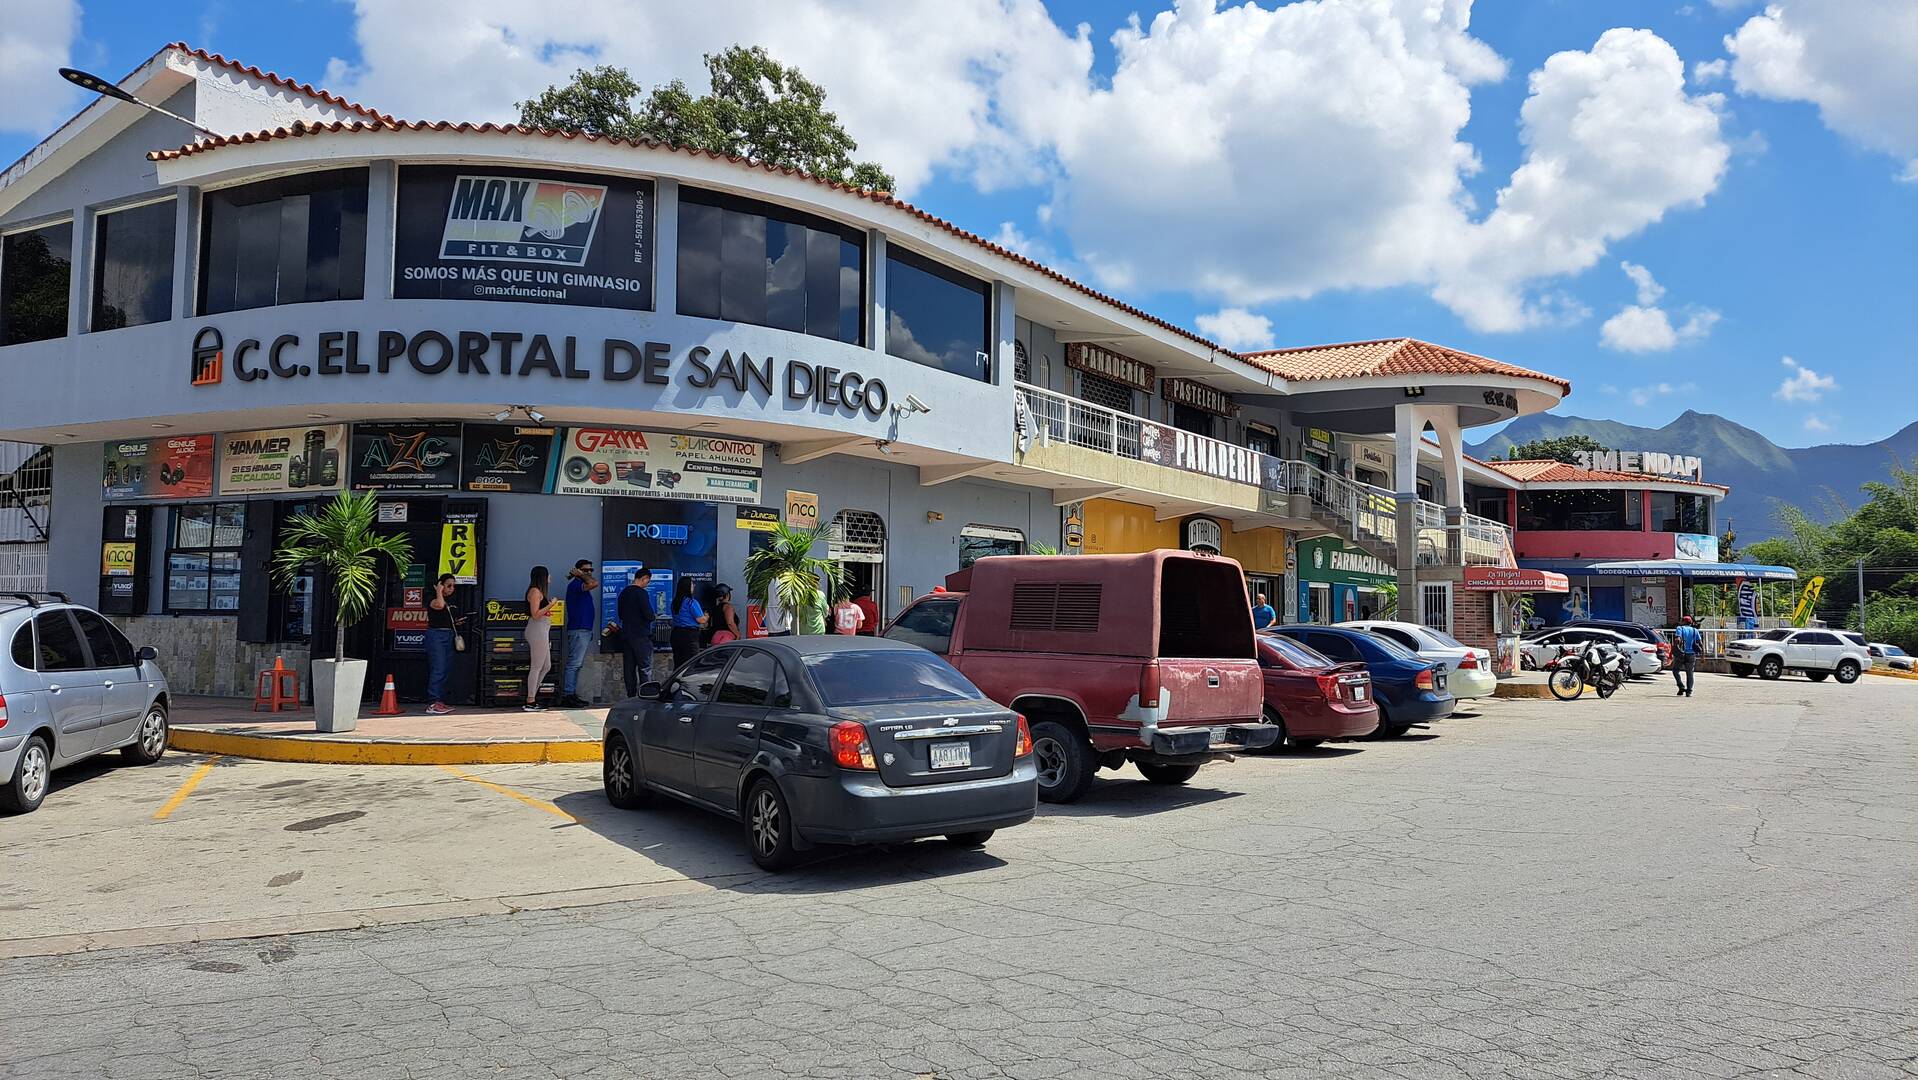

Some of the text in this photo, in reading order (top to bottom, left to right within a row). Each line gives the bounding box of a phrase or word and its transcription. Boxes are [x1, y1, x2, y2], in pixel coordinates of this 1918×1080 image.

[451, 179, 530, 222] MAX
[468, 243, 567, 260] FIT & BOX
[634, 247, 643, 264] RIF
[404, 265, 641, 291] SOMOS MÁS QUE UN GIMNASIO
[484, 285, 567, 299] maxfuncional
[232, 330, 889, 415] C.C. EL PORTAL DE SAN DIEGO
[118, 443, 148, 453] GENIUS
[167, 439, 197, 449] GENIUS
[229, 437, 291, 455] HAMMER
[675, 451, 752, 464] PAPEL AHUMADO
[1175, 431, 1262, 485] PANADERIA
[687, 463, 712, 471] CENTRO
[242, 472, 282, 482] CALIDAD
[562, 486, 580, 494] VENTA
[584, 486, 620, 495] INSTALACIÓN
[628, 489, 660, 497] AUTOPARTES
[671, 491, 695, 499] BOUTIQUE
[447, 525, 469, 575] RCV
[1329, 550, 1377, 574] FARMACIA
[1598, 567, 1633, 575] BODEGÓN
